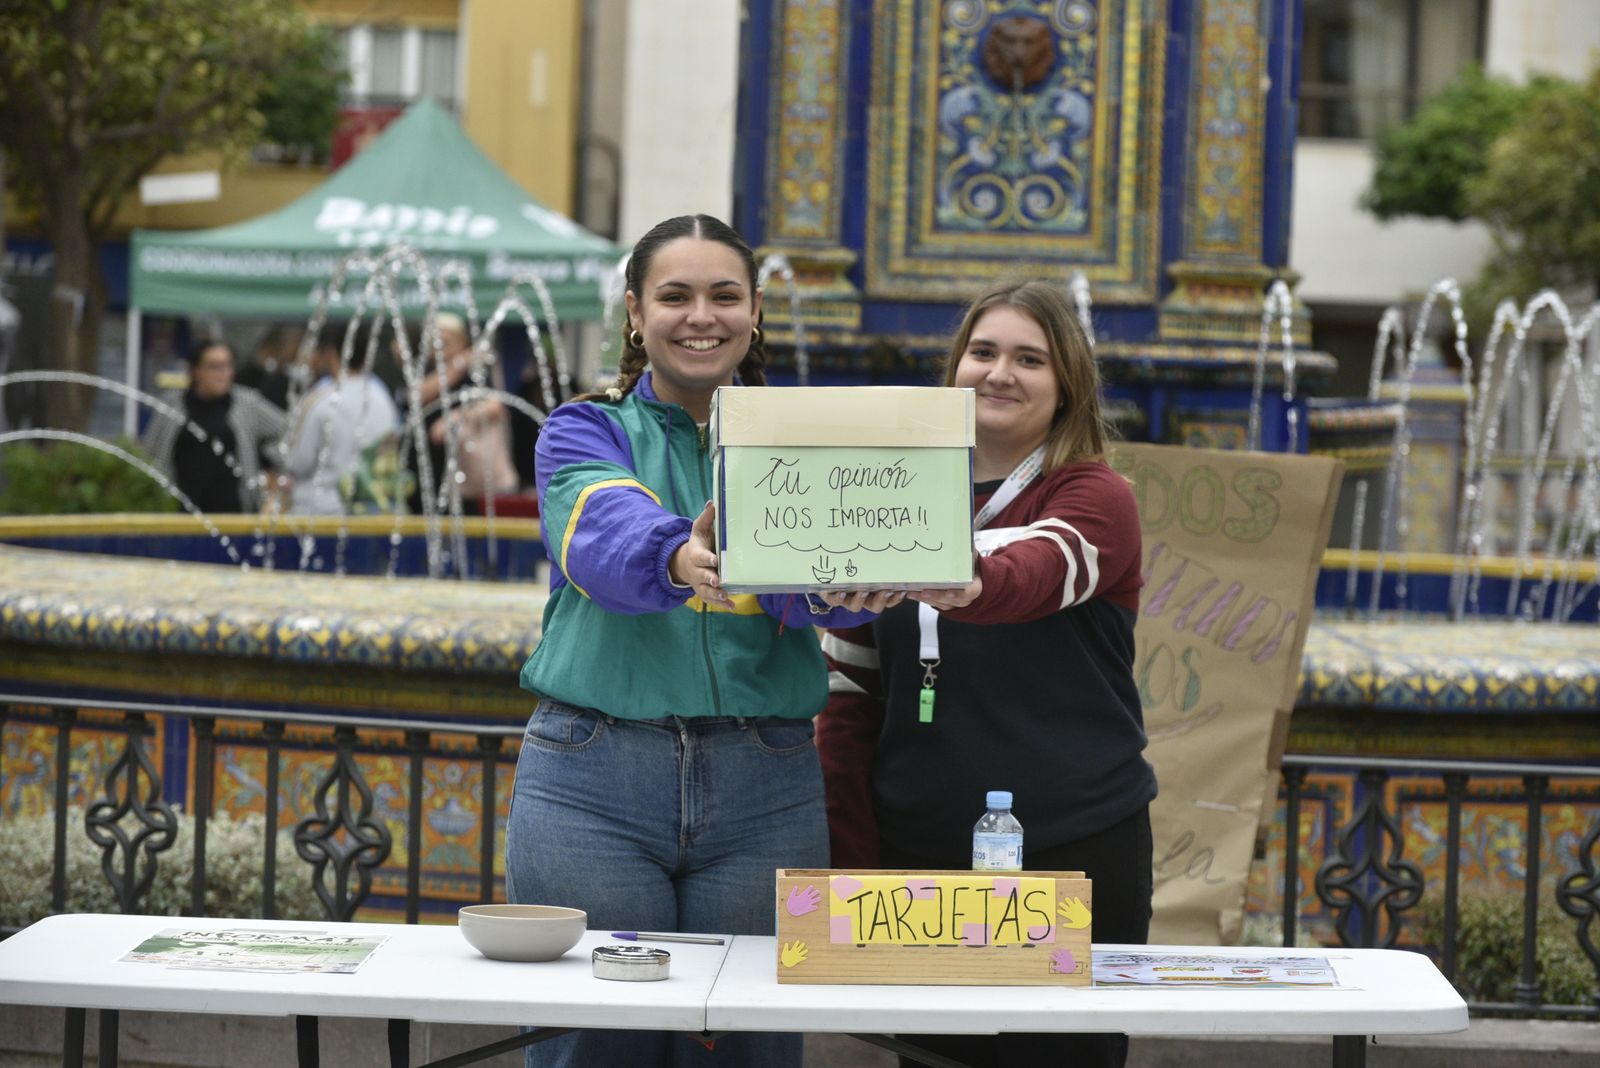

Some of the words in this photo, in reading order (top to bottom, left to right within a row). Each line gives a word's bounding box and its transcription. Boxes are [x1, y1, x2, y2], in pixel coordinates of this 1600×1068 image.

[828, 457, 918, 507] opinión
[764, 506, 813, 530] NOS
[827, 505, 929, 531] IMPORTA!!
[847, 886, 1051, 945] TARJETAS
